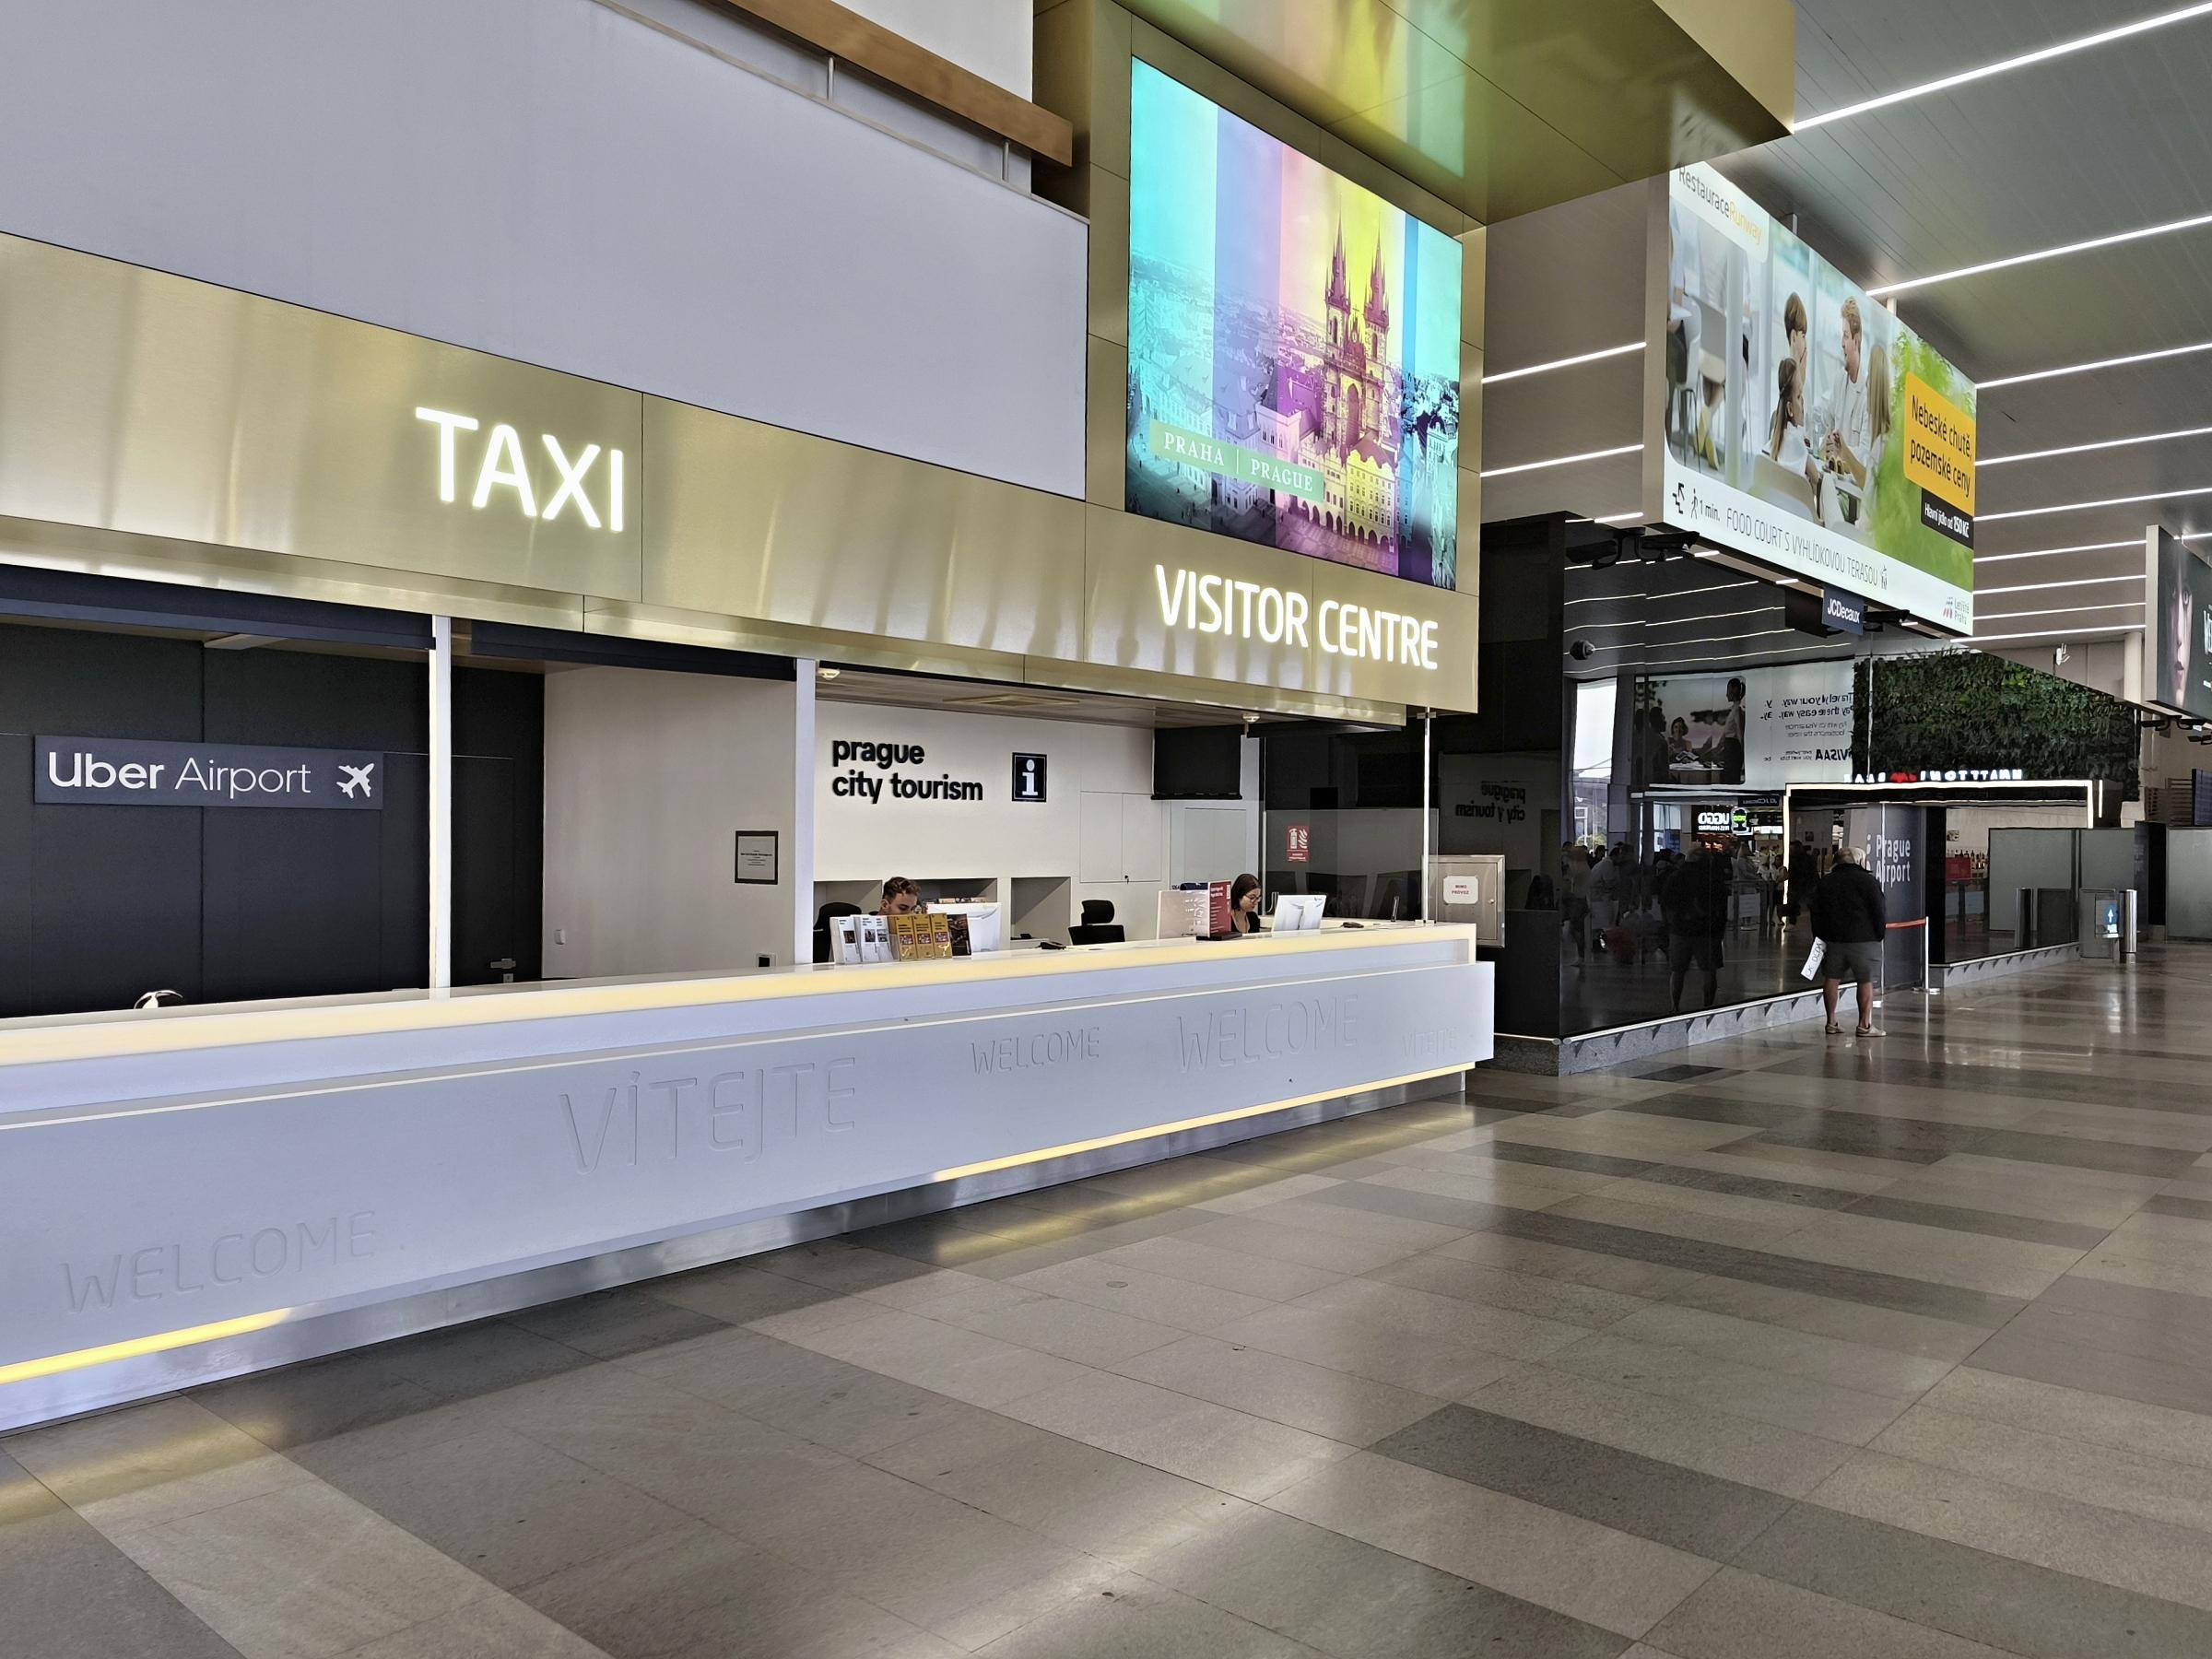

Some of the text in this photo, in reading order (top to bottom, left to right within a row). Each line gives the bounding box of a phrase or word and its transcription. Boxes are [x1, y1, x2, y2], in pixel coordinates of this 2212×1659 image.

[1911, 394, 1947, 442] Nebeské
[415, 406, 624, 533] TAXI
[1164, 431, 1314, 493] PRAHA PRAGUE
[1910, 439, 1971, 498] pozemské ceny
[1726, 507, 1752, 536] FOOD
[1754, 519, 1783, 549] COURT
[1784, 532, 1790, 552] S
[1846, 556, 1878, 586] TERASOU
[1155, 564, 1439, 670] VISITOR CENTRE
[1827, 598, 1860, 624] JCDecaux
[49, 751, 312, 800] Uber Airport
[831, 739, 925, 769] prague
[831, 771, 983, 804] city tourism
[1876, 834, 1911, 863] Prague
[1876, 860, 1911, 888] Airport
[971, 1026, 1100, 1076] WELCOME
[1176, 994, 1359, 1075] WELCOME
[559, 1056, 855, 1175] VÍTEJTE
[60, 1210, 375, 1314] WELCOME
